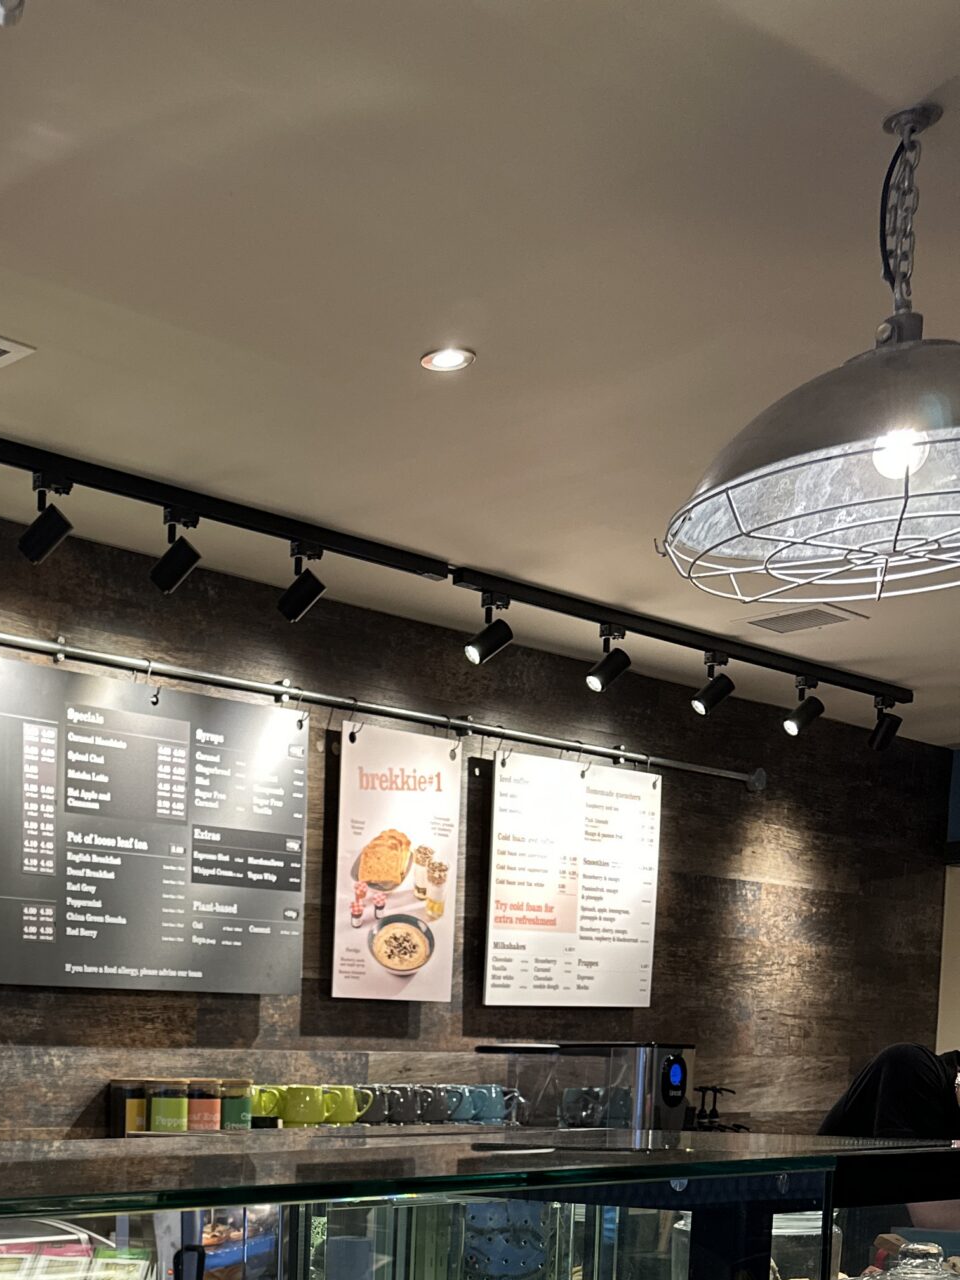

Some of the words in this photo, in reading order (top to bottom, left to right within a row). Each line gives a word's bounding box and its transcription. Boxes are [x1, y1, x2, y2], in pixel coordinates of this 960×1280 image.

[358, 766, 442, 792] brekkie#1
[67, 831, 82, 843] Pot
[84, 834, 94, 844] of
[94, 835, 116, 846] loose
[117, 837, 134, 848] leaf
[134, 840, 148, 850] tea
[194, 828, 221, 841] Extras
[193, 901, 237, 914] Plant-based
[495, 900, 507, 913] Try
[510, 902, 524, 911] cold
[526, 903, 542, 912] foam
[544, 903, 554, 913] for
[495, 915, 513, 924] extra
[515, 916, 556, 926] refreshment
[493, 942, 526, 950] Milkshakes
